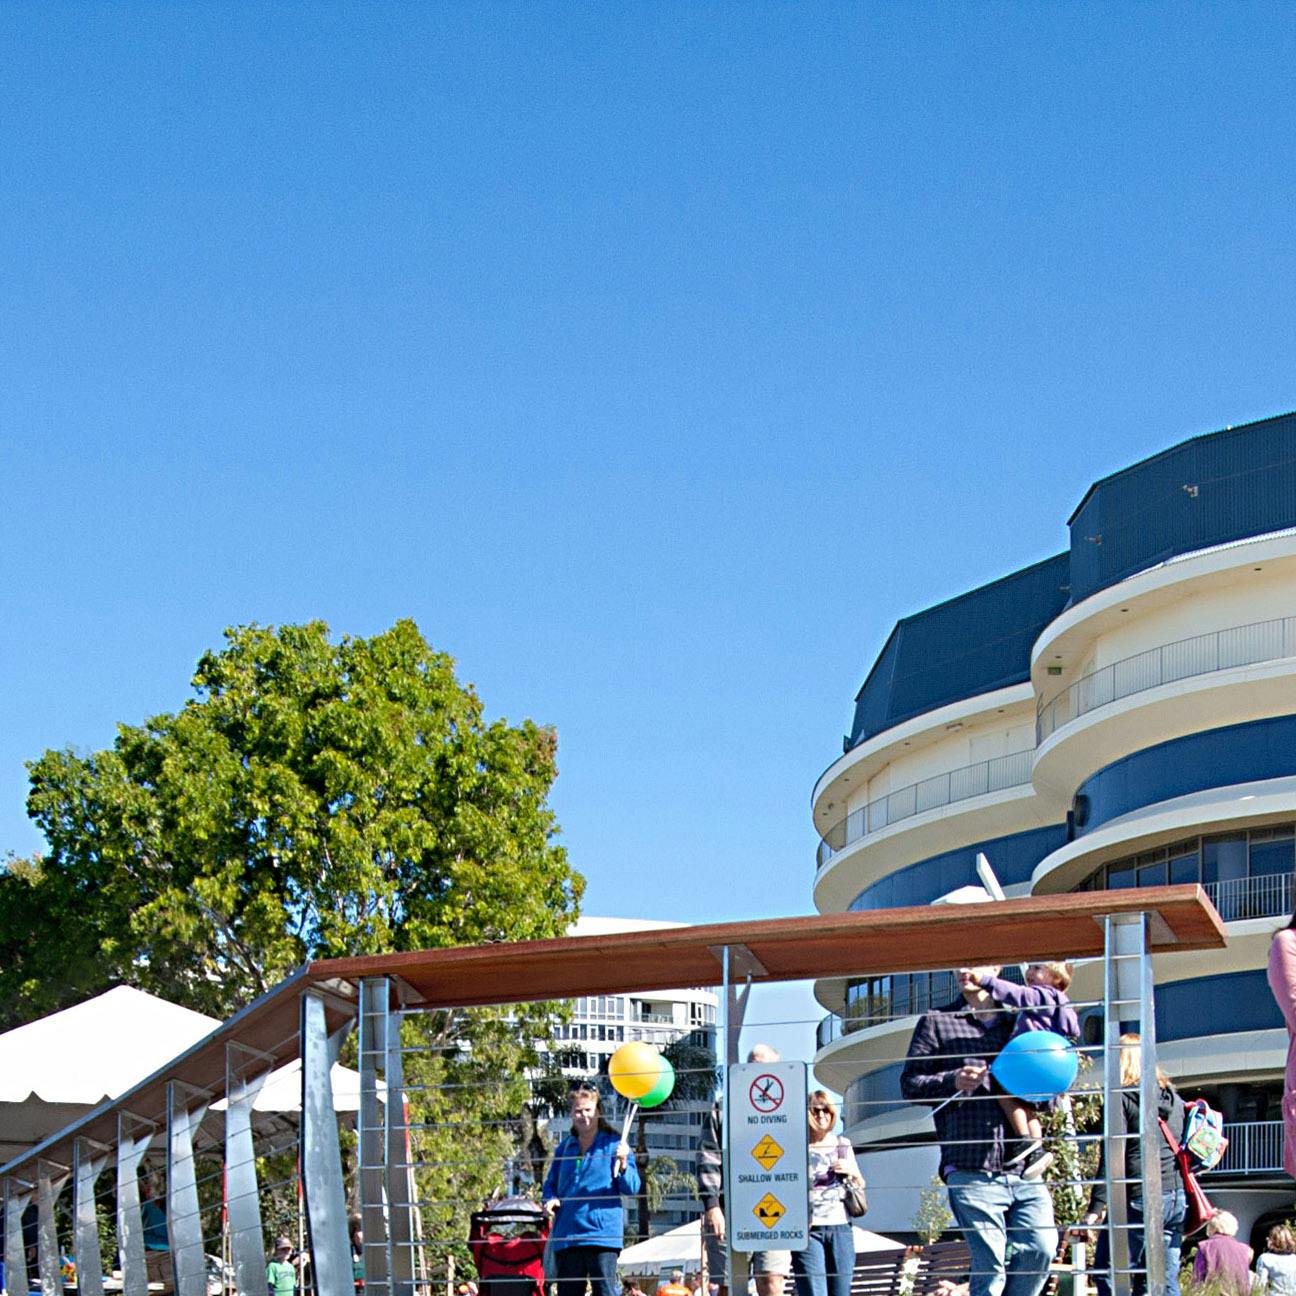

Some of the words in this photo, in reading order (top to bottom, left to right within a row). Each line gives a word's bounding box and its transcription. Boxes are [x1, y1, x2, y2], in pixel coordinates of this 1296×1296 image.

[747, 1116, 759, 1125] NO
[760, 1115, 787, 1124] DIVING
[738, 1174, 772, 1183] SHALLOW
[774, 1173, 799, 1182] WATER
[737, 1231, 779, 1240] SUBMERGED
[780, 1230, 803, 1240] ROCKS
